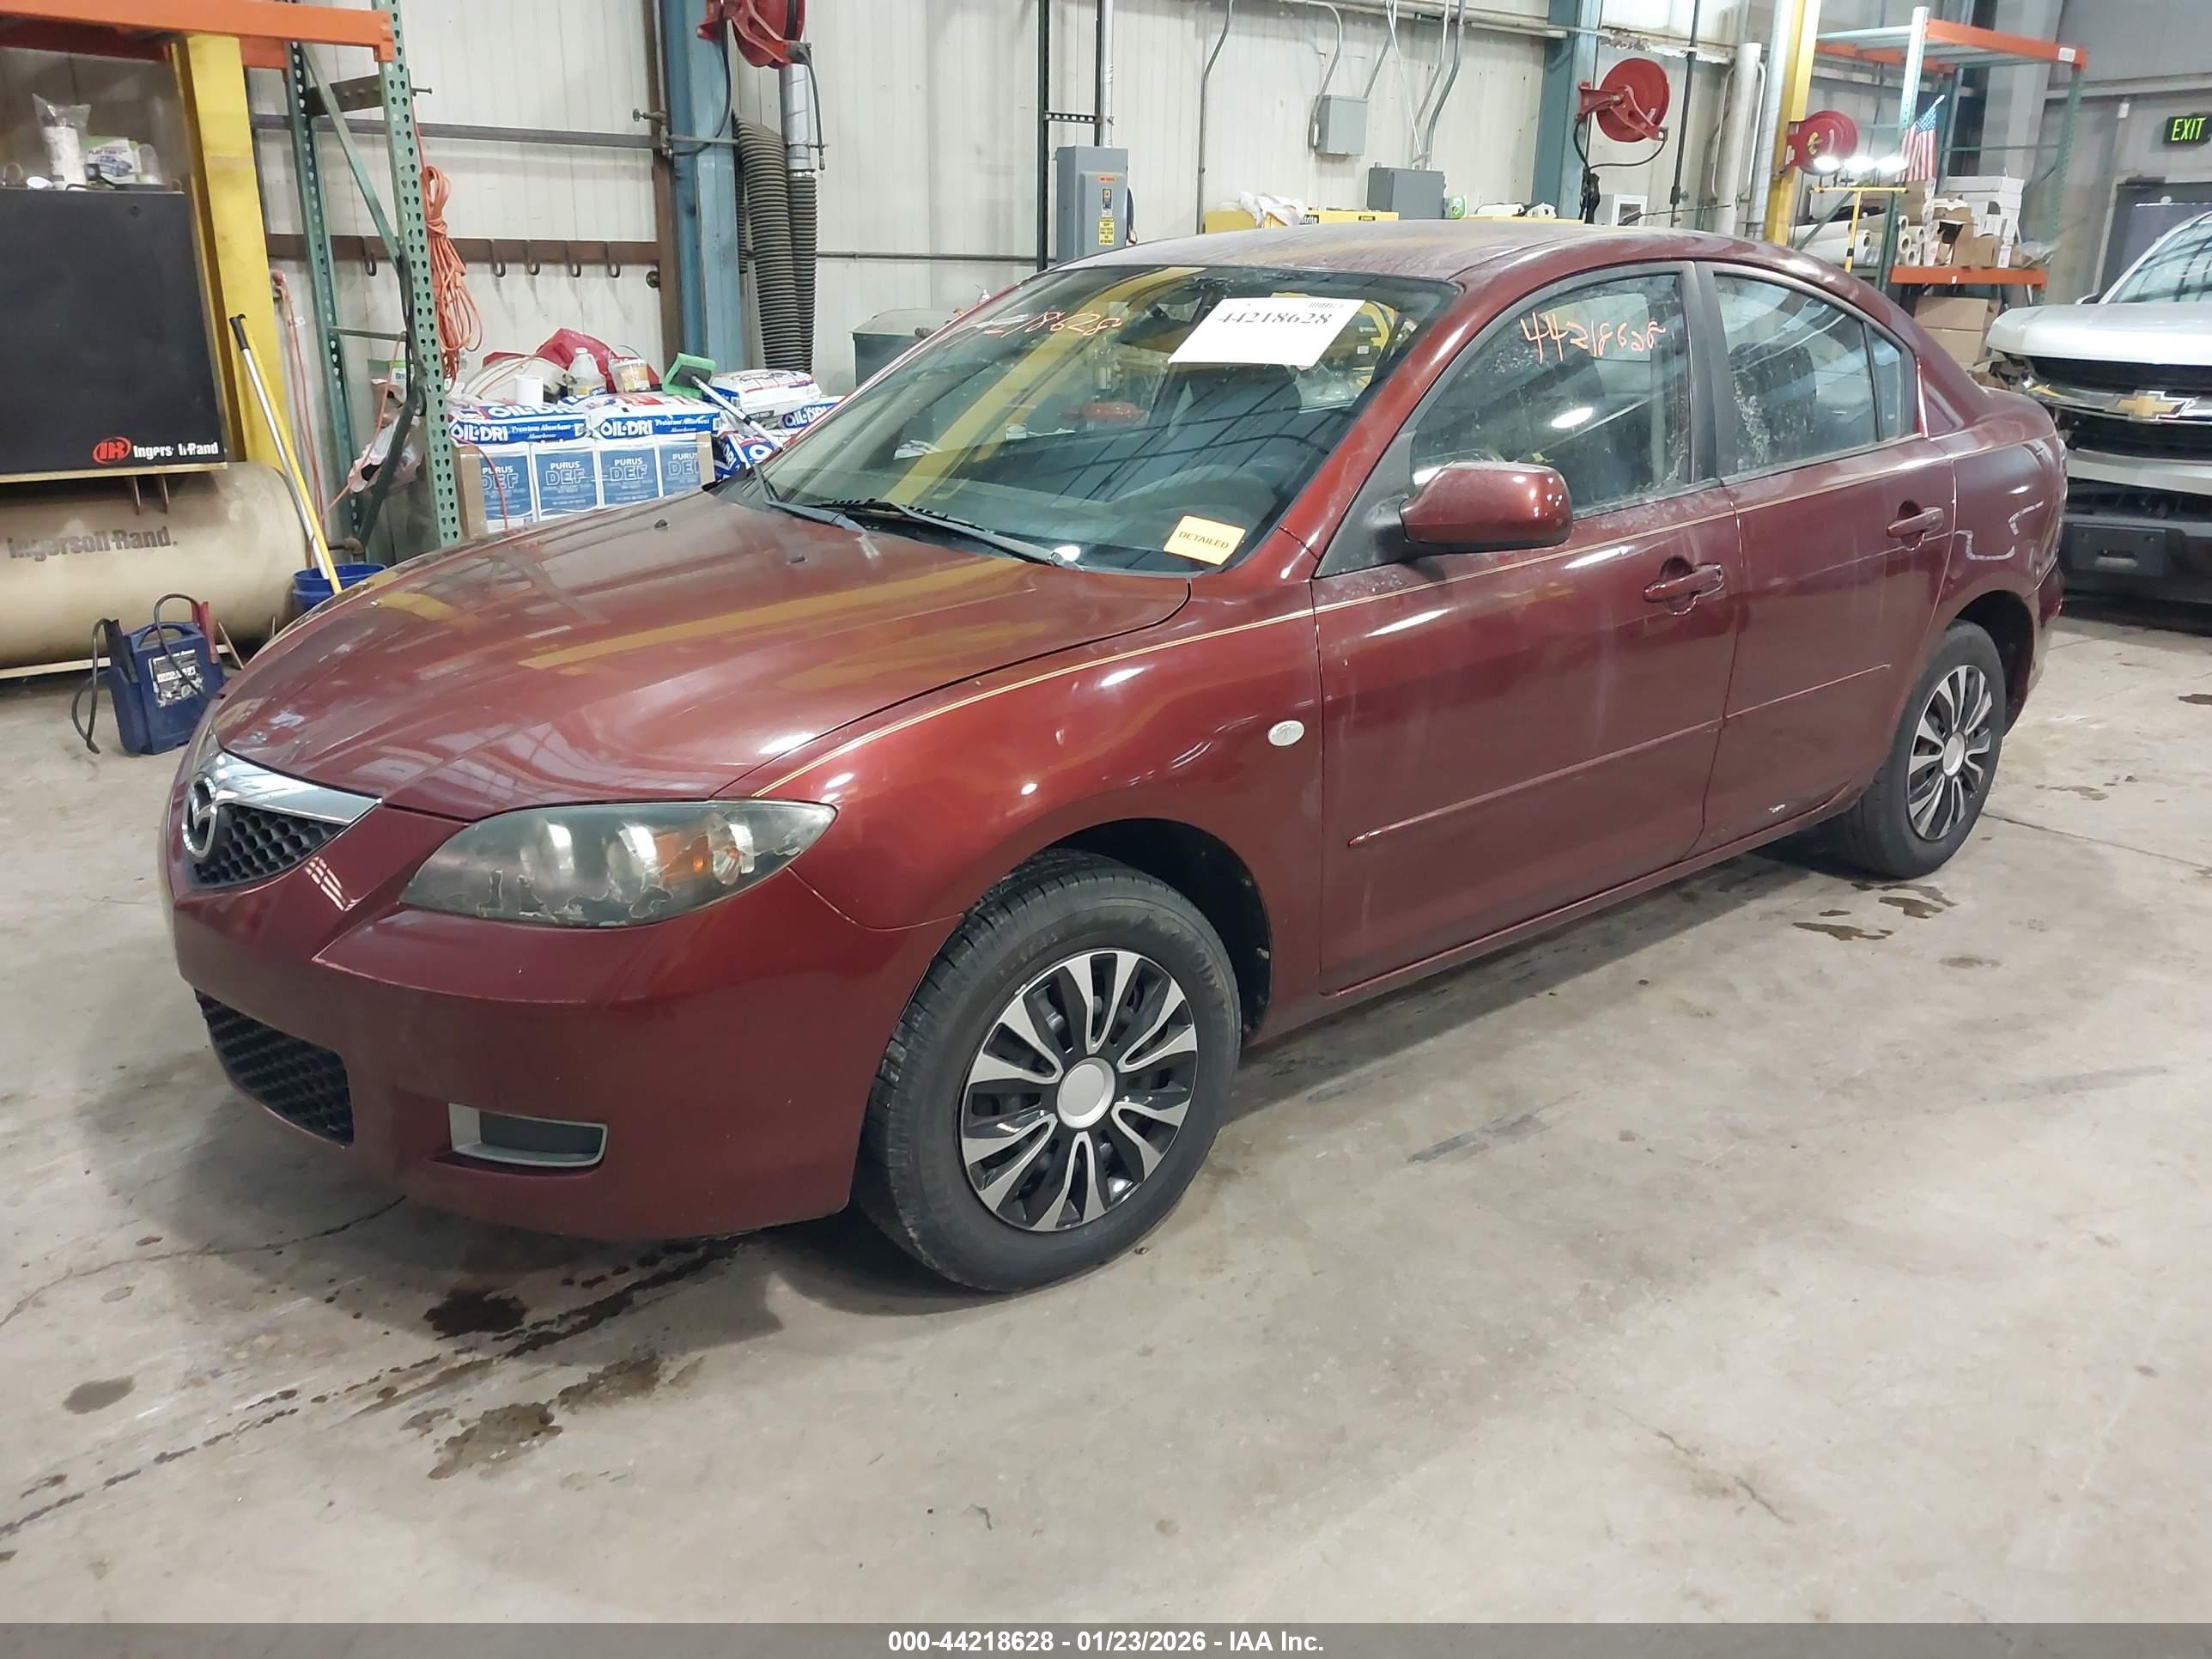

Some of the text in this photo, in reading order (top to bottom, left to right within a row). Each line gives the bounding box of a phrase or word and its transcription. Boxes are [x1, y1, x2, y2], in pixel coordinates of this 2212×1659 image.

[2171, 118, 2206, 141] EXIT
[1218, 313, 1332, 323] 44218628
[1520, 311, 1667, 364] 44218628
[550, 460, 580, 470] PURUS
[614, 457, 643, 466] PURUS
[545, 468, 585, 486] DEF
[610, 465, 647, 482] DEF
[1178, 531, 1230, 549] DETAILED
